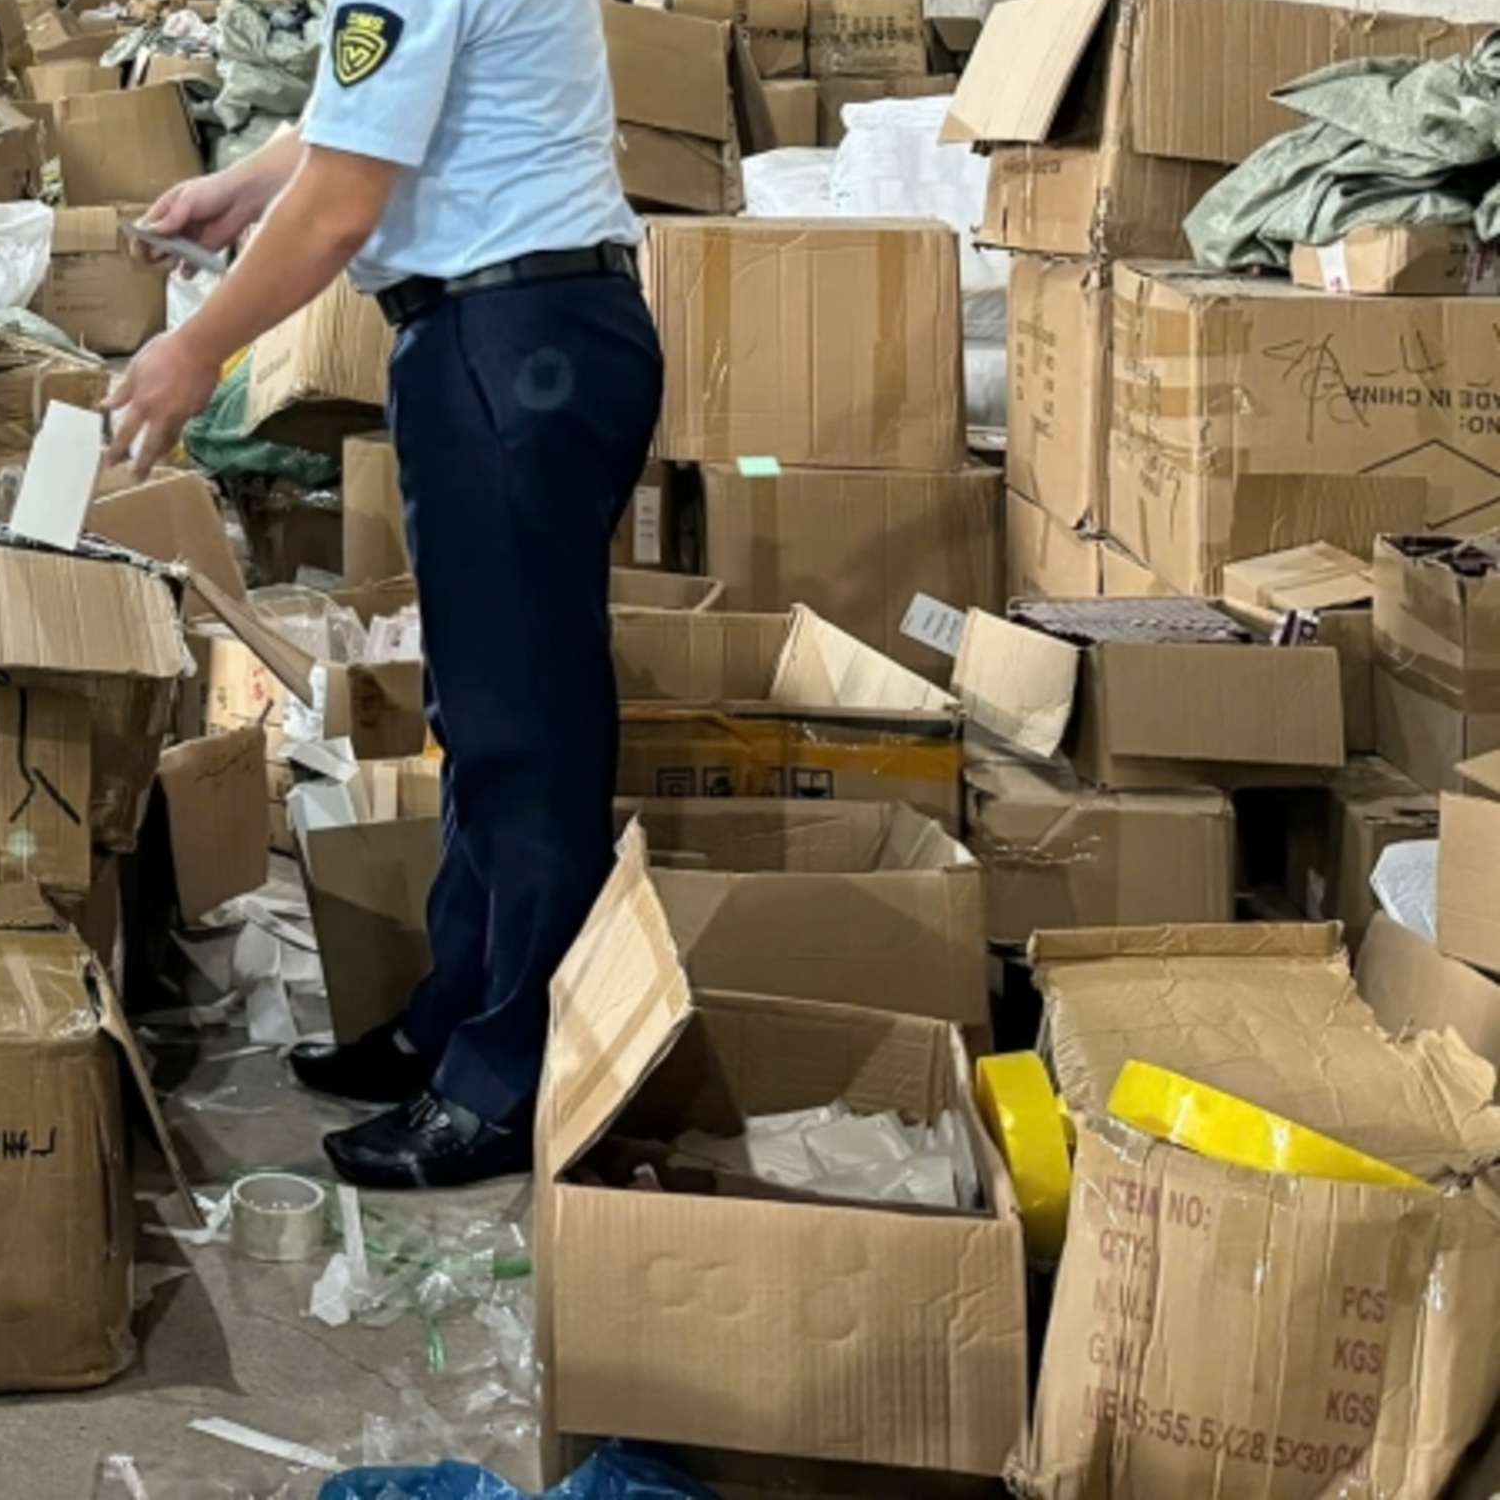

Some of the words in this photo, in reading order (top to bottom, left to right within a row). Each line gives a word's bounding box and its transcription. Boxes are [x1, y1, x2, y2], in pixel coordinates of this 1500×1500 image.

[1347, 385, 1421, 407] CHINA
[1429, 388, 1451, 408] IN
[1340, 1286, 1388, 1323] PCS
[1332, 1336, 1383, 1375] KGS
[1325, 1388, 1377, 1428] KGS
